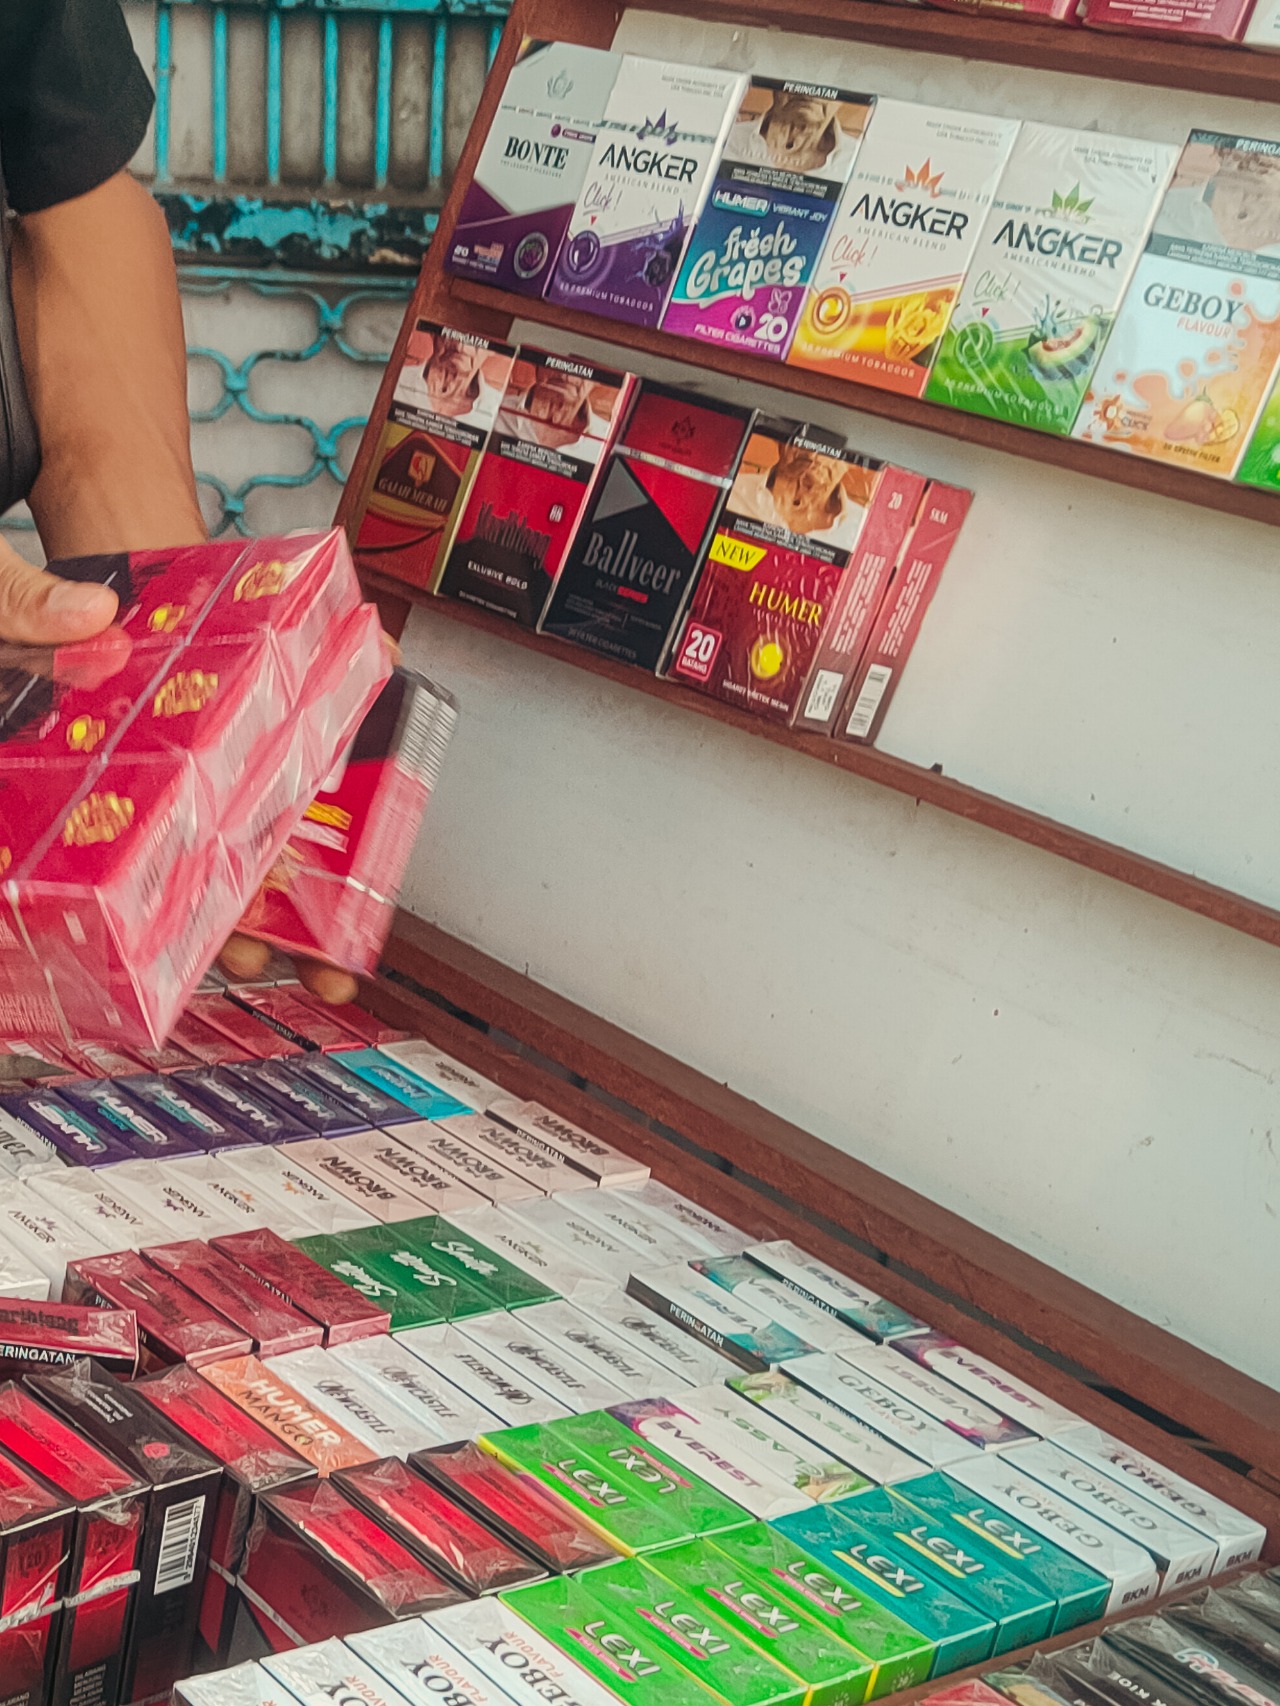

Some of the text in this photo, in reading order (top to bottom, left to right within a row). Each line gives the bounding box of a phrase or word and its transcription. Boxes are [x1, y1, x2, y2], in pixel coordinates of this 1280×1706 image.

[783, 82, 838, 99] PERINGATAN
[504, 136, 569, 170] BONTE
[599, 143, 698, 183] ANGKER
[716, 191, 768, 212] HUMER
[773, 203, 828, 222] VIBRANT JOY
[850, 193, 968, 239] ANGKER
[857, 225, 946, 251] AMERICAN BLEND
[993, 219, 1123, 269] ANGKER
[1004, 251, 1058, 269] AMERICAN
[686, 250, 805, 301] Grapes
[1144, 282, 1243, 323] GEBOY
[441, 327, 490, 349] PERINGATAN
[754, 313, 788, 342] 20
[1177, 315, 1231, 339] FLAVOUR
[546, 357, 593, 378] PERINGATAN
[888, 491, 902, 510] 20
[929, 507, 948, 525] SKM
[582, 530, 681, 595] Ballveer
[716, 540, 756, 566] NEW
[749, 582, 822, 627] HUMER
[685, 629, 716, 663] 20
[479, 1127, 556, 1170] BROWN
[533, 1115, 610, 1156] BROWN
[320, 1156, 398, 1200] BROWN
[375, 1147, 452, 1190] BROWN
[429, 1138, 506, 1181] BROWN
[8, 1208, 56, 1244] ANGKER
[939, 1350, 1044, 1410] EVEREST
[239, 1390, 313, 1446] MANGO
[249, 1379, 342, 1447] HUMER
[838, 1374, 938, 1433] GEBOY
[657, 1421, 763, 1489] EVEREST
[713, 1407, 823, 1477] CLASSY
[557, 1459, 627, 1504] LEXI
[608, 1448, 677, 1494] LEXI
[1099, 1451, 1208, 1518] GEBOY
[993, 1484, 1104, 1549] GEBOY
[1049, 1468, 1158, 1531] GEBOY
[910, 1526, 985, 1574] LEXI
[968, 1508, 1042, 1555] LEXI
[786, 1560, 863, 1613] LEXI
[850, 1543, 925, 1593] LEXI
[654, 1601, 731, 1656] LEXI
[723, 1580, 800, 1634] LEXI
[503, 1631, 564, 1679] FLAVOUR
[584, 1620, 662, 1679] LEXI
[427, 1654, 488, 1703] FLAVOUR
